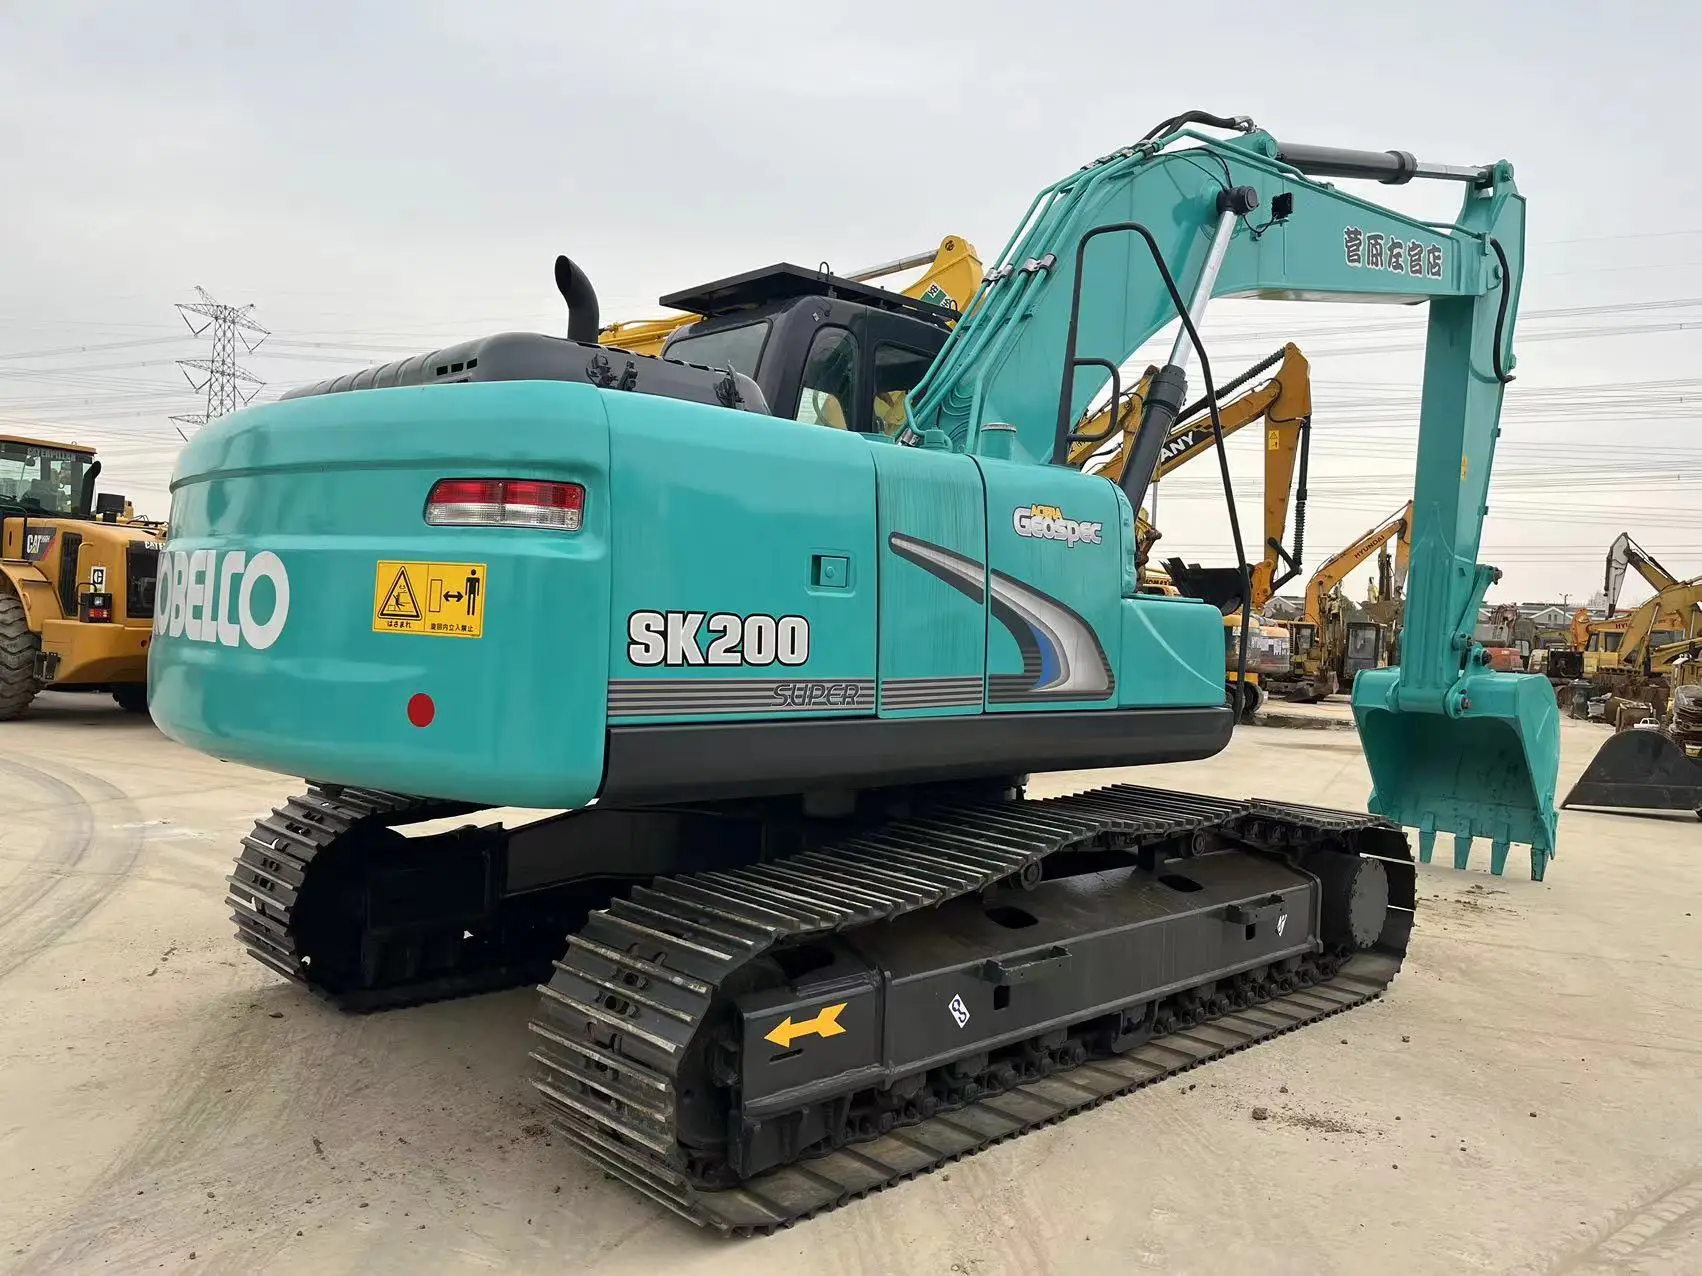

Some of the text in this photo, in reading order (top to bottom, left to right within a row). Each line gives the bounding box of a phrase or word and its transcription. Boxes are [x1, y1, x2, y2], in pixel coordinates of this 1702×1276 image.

[26, 534, 41, 554] CAT
[1353, 534, 1385, 559] HYUNDAI
[386, 620, 412, 629] はさまれ
[627, 609, 809, 667] SK200
[772, 683, 860, 707] SUPER
